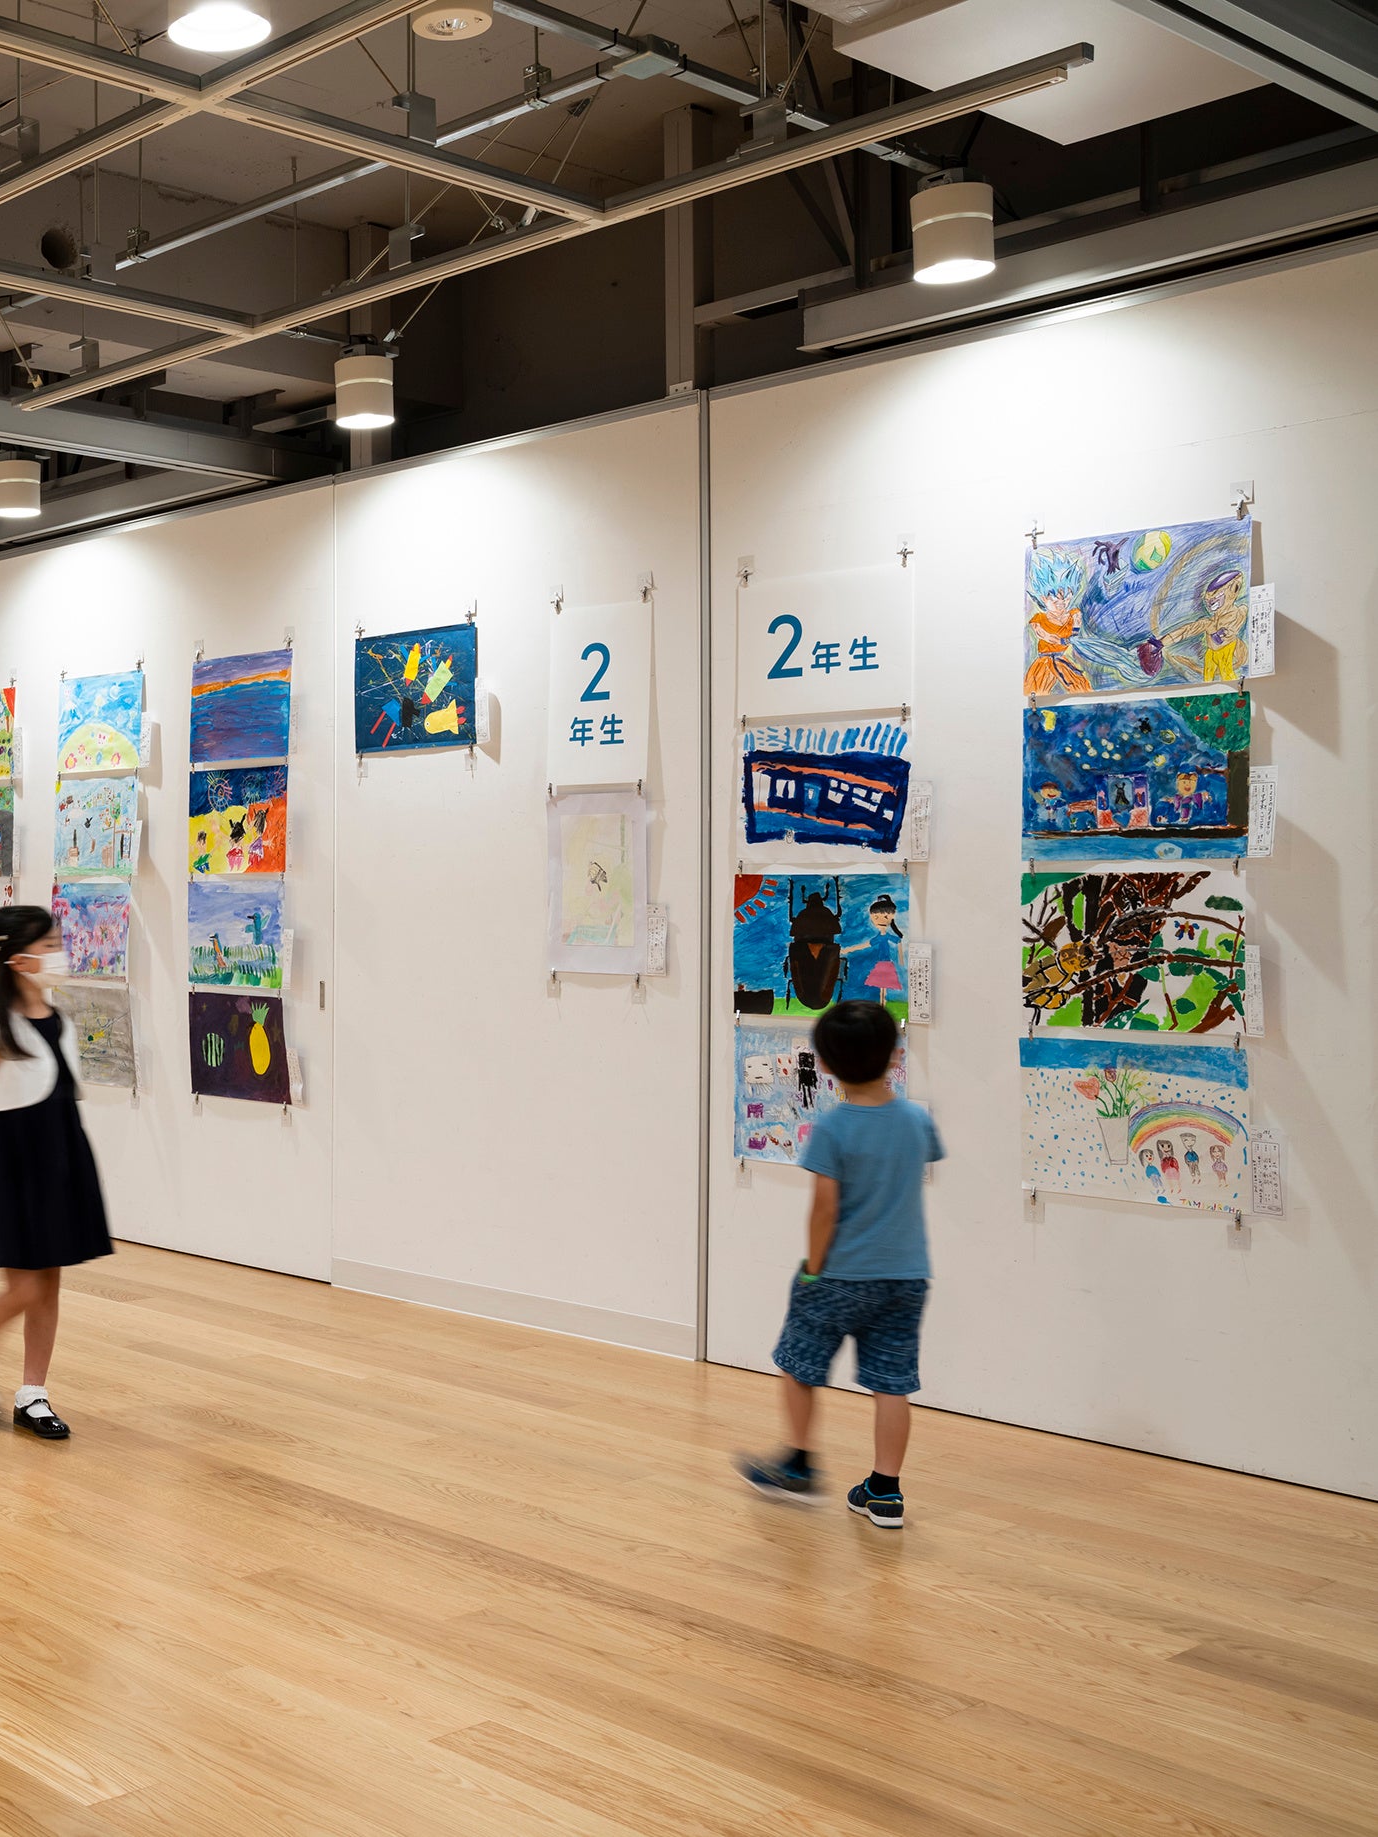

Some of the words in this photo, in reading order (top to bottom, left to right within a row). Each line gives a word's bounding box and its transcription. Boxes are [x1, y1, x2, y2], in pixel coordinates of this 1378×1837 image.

[579, 642, 611, 703] 2
[767, 613, 880, 680] 2年生
[568, 713, 624, 747] 年生
